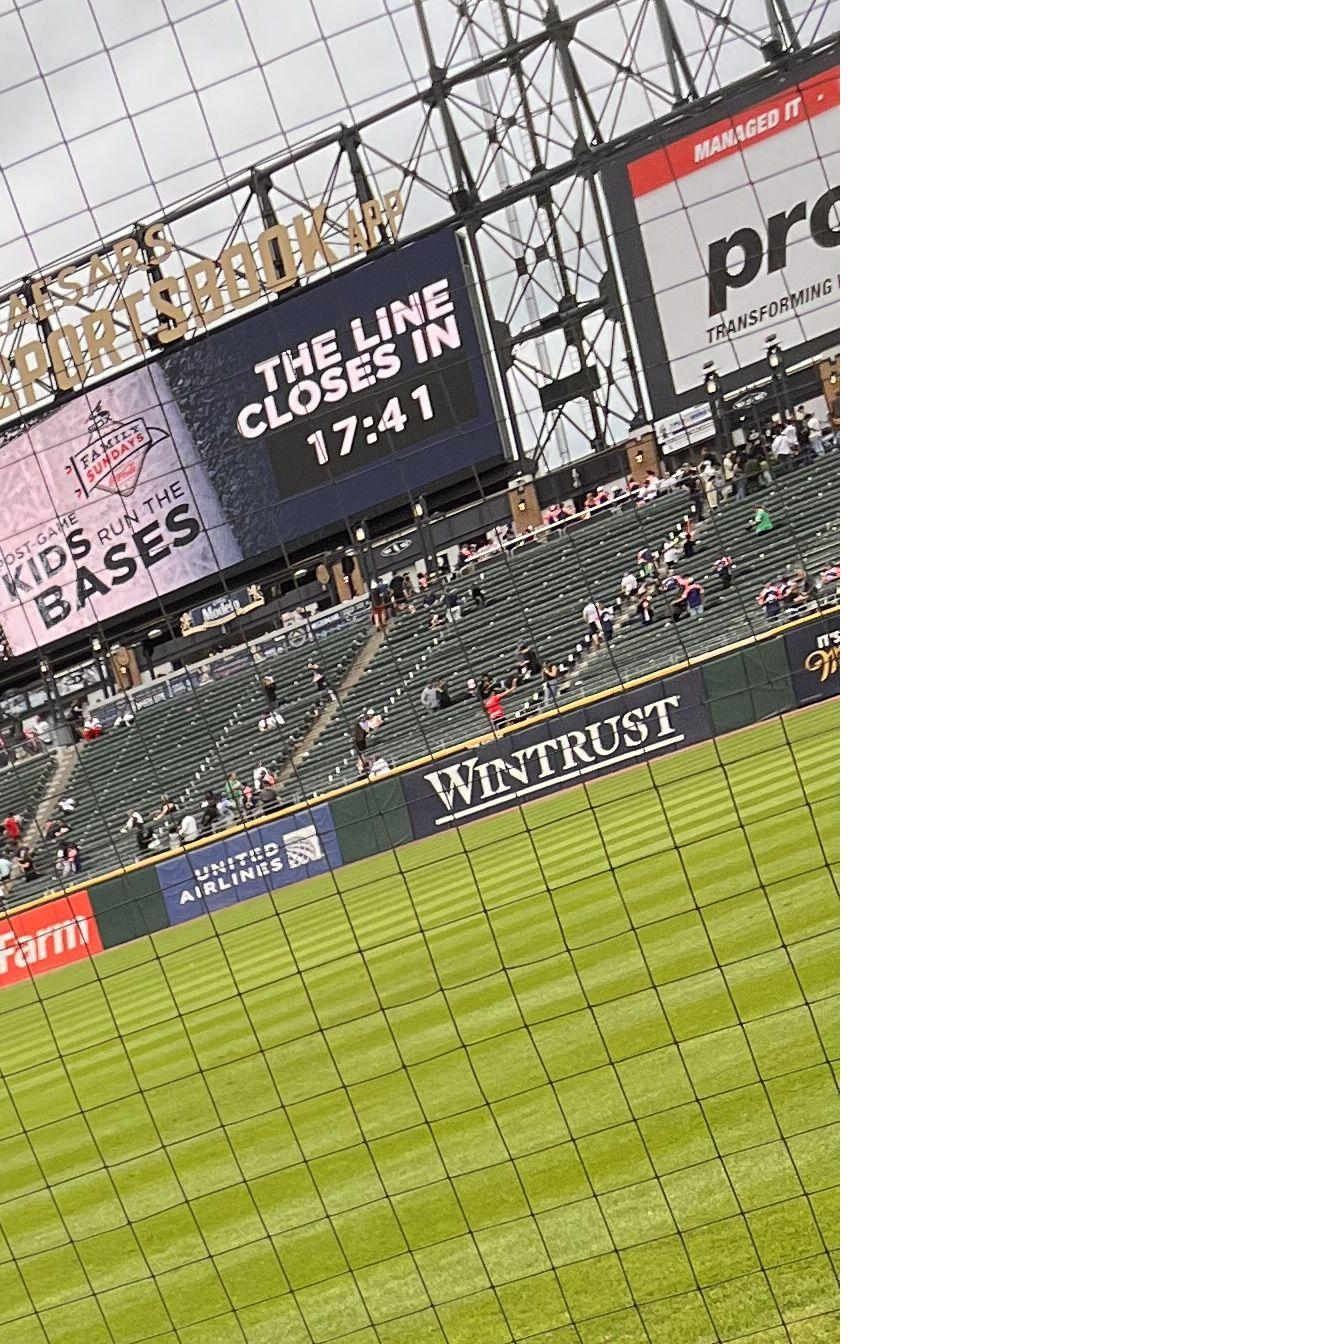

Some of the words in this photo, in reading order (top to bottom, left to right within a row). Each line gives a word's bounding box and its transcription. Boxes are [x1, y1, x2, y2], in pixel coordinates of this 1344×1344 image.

[694, 107, 780, 163] MANAGED
[784, 97, 802, 121] IT
[348, 190, 403, 253] APP
[254, 329, 342, 393] THE
[350, 278, 454, 352] LINE
[706, 281, 832, 344] TRANSFORMING
[237, 343, 401, 439] CLOSES
[412, 314, 461, 364] IN
[80, 424, 140, 470] FAMILY
[86, 432, 146, 483] SUNDAYS
[307, 384, 434, 466] 17:41
[2, 528, 92, 602] KIDS
[97, 513, 141, 546] RUN
[143, 480, 185, 514] THE
[34, 503, 201, 631] BASES
[424, 695, 681, 812] WINTRUST
[179, 857, 284, 905] AIRLINES
[194, 842, 279, 882] UNITED
